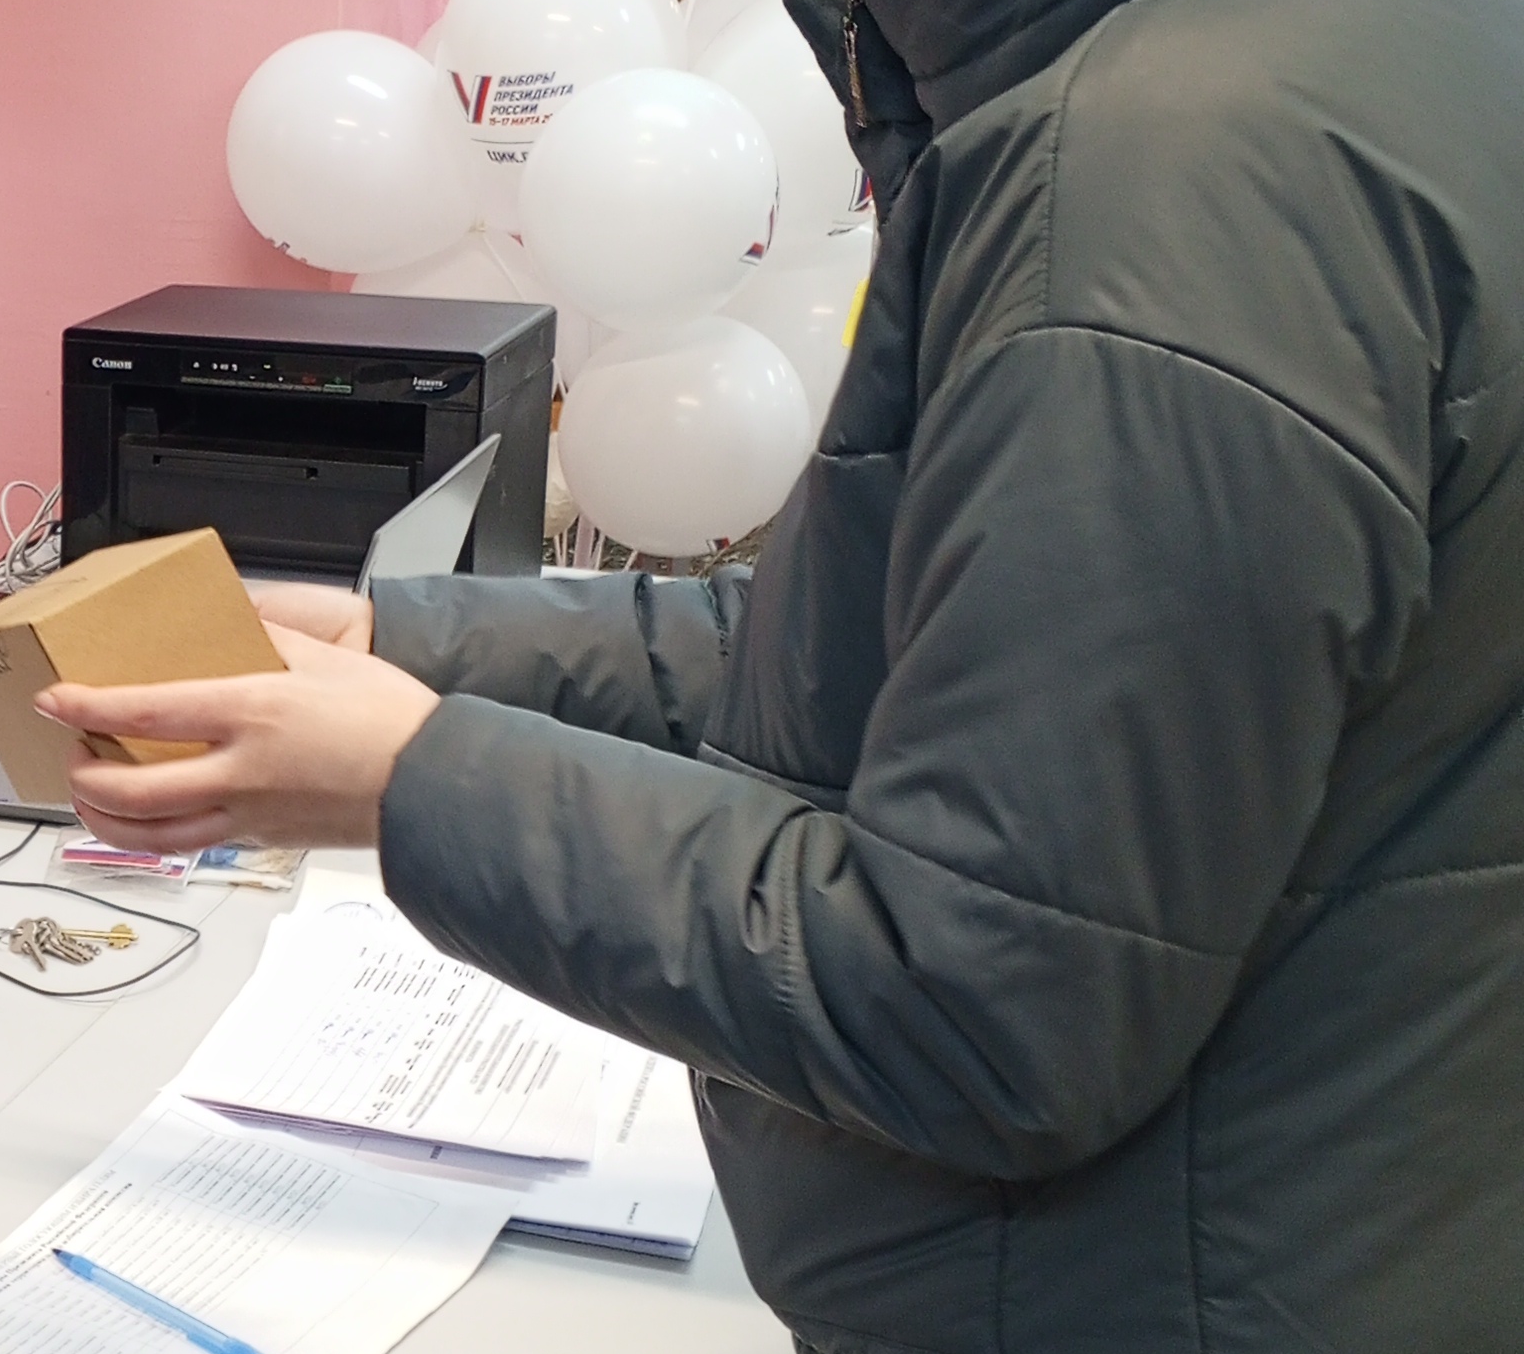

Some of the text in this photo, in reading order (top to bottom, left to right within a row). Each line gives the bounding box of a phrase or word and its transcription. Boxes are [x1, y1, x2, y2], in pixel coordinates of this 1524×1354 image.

[498, 71, 556, 87] ВЫБОРЫ
[494, 84, 574, 102] ПРЕЗИДЕНТА
[491, 104, 539, 115] РОССИИ
[510, 116, 540, 125] МАРТА
[92, 357, 133, 370] Canon
